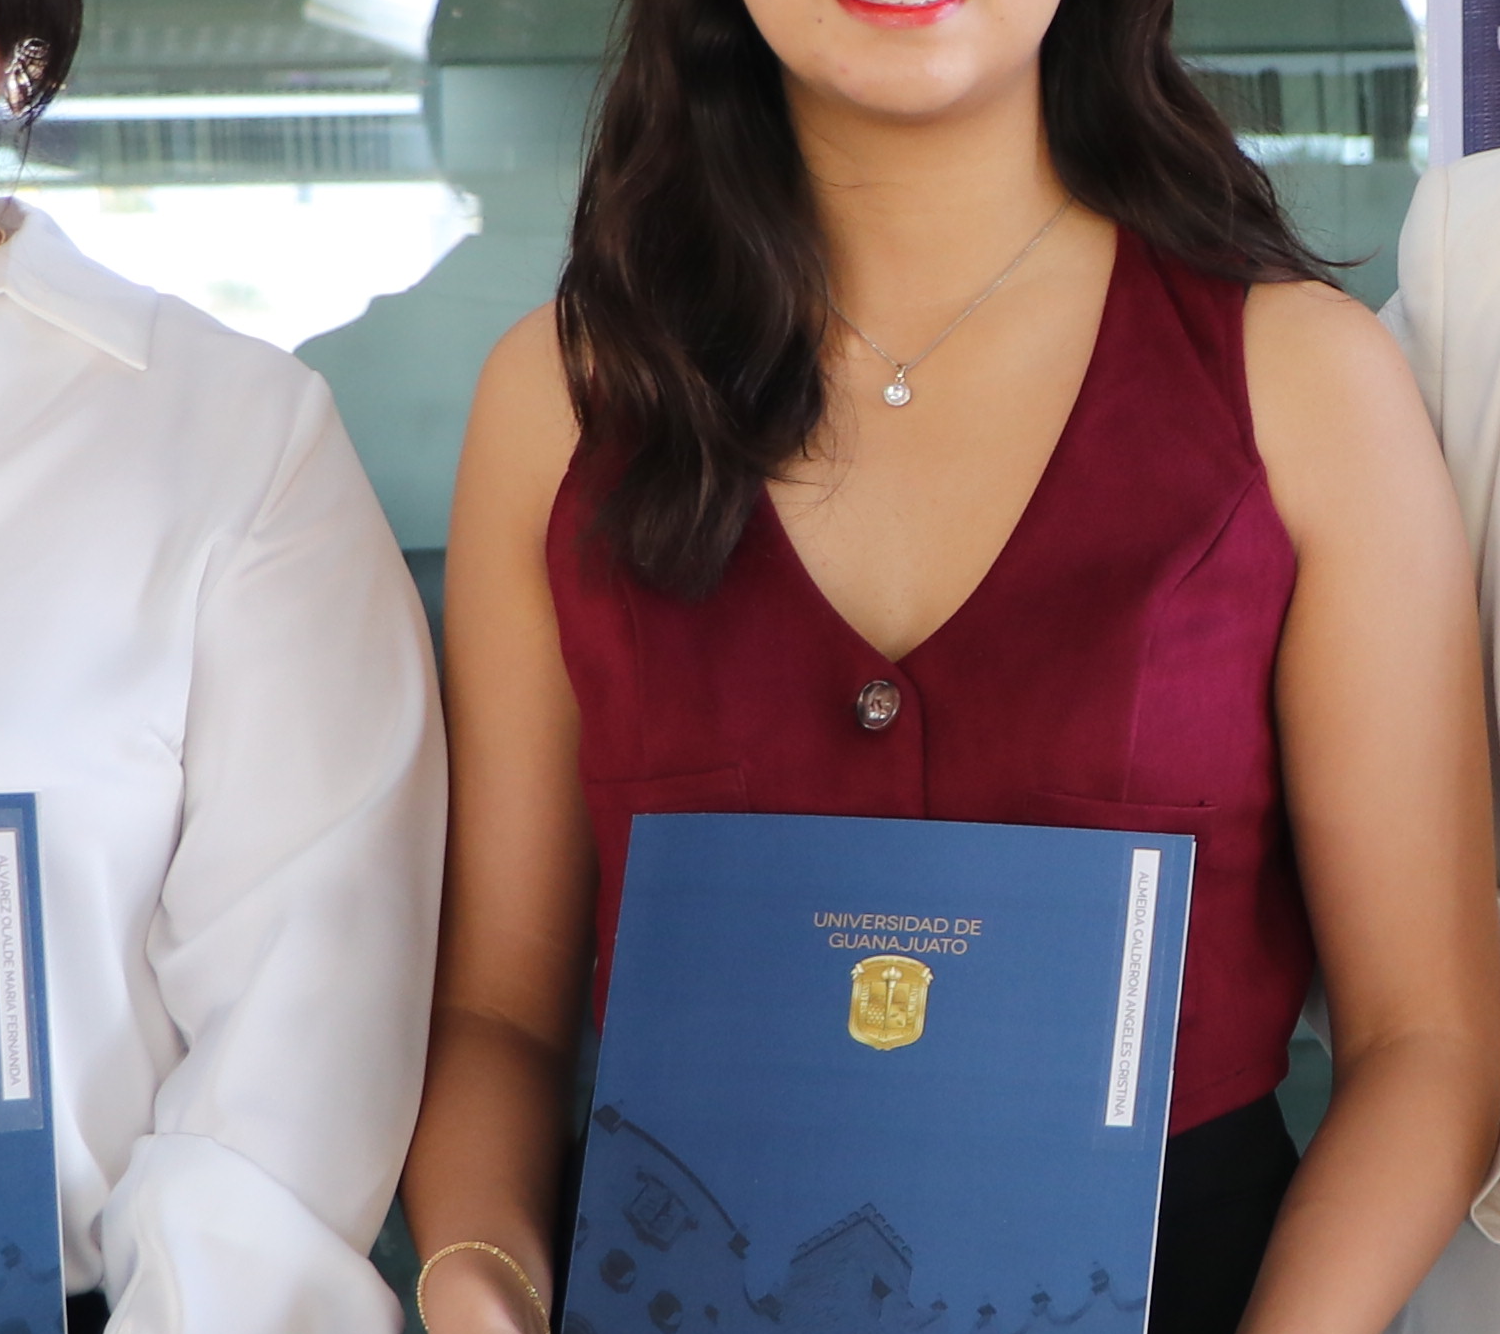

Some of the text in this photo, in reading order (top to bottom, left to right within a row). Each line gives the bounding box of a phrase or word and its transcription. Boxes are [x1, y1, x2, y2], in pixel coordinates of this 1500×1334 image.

[1, 916, 15, 968] OLALDE
[814, 912, 982, 936] UNIVERSIDAD DE
[829, 933, 968, 955] GUANAJUATO
[4, 970, 17, 1012] MARIA
[1115, 871, 1150, 1117] ALMEIDA CALDERON ANGELES CRISTINA
[7, 1015, 21, 1086] FERNANDA
